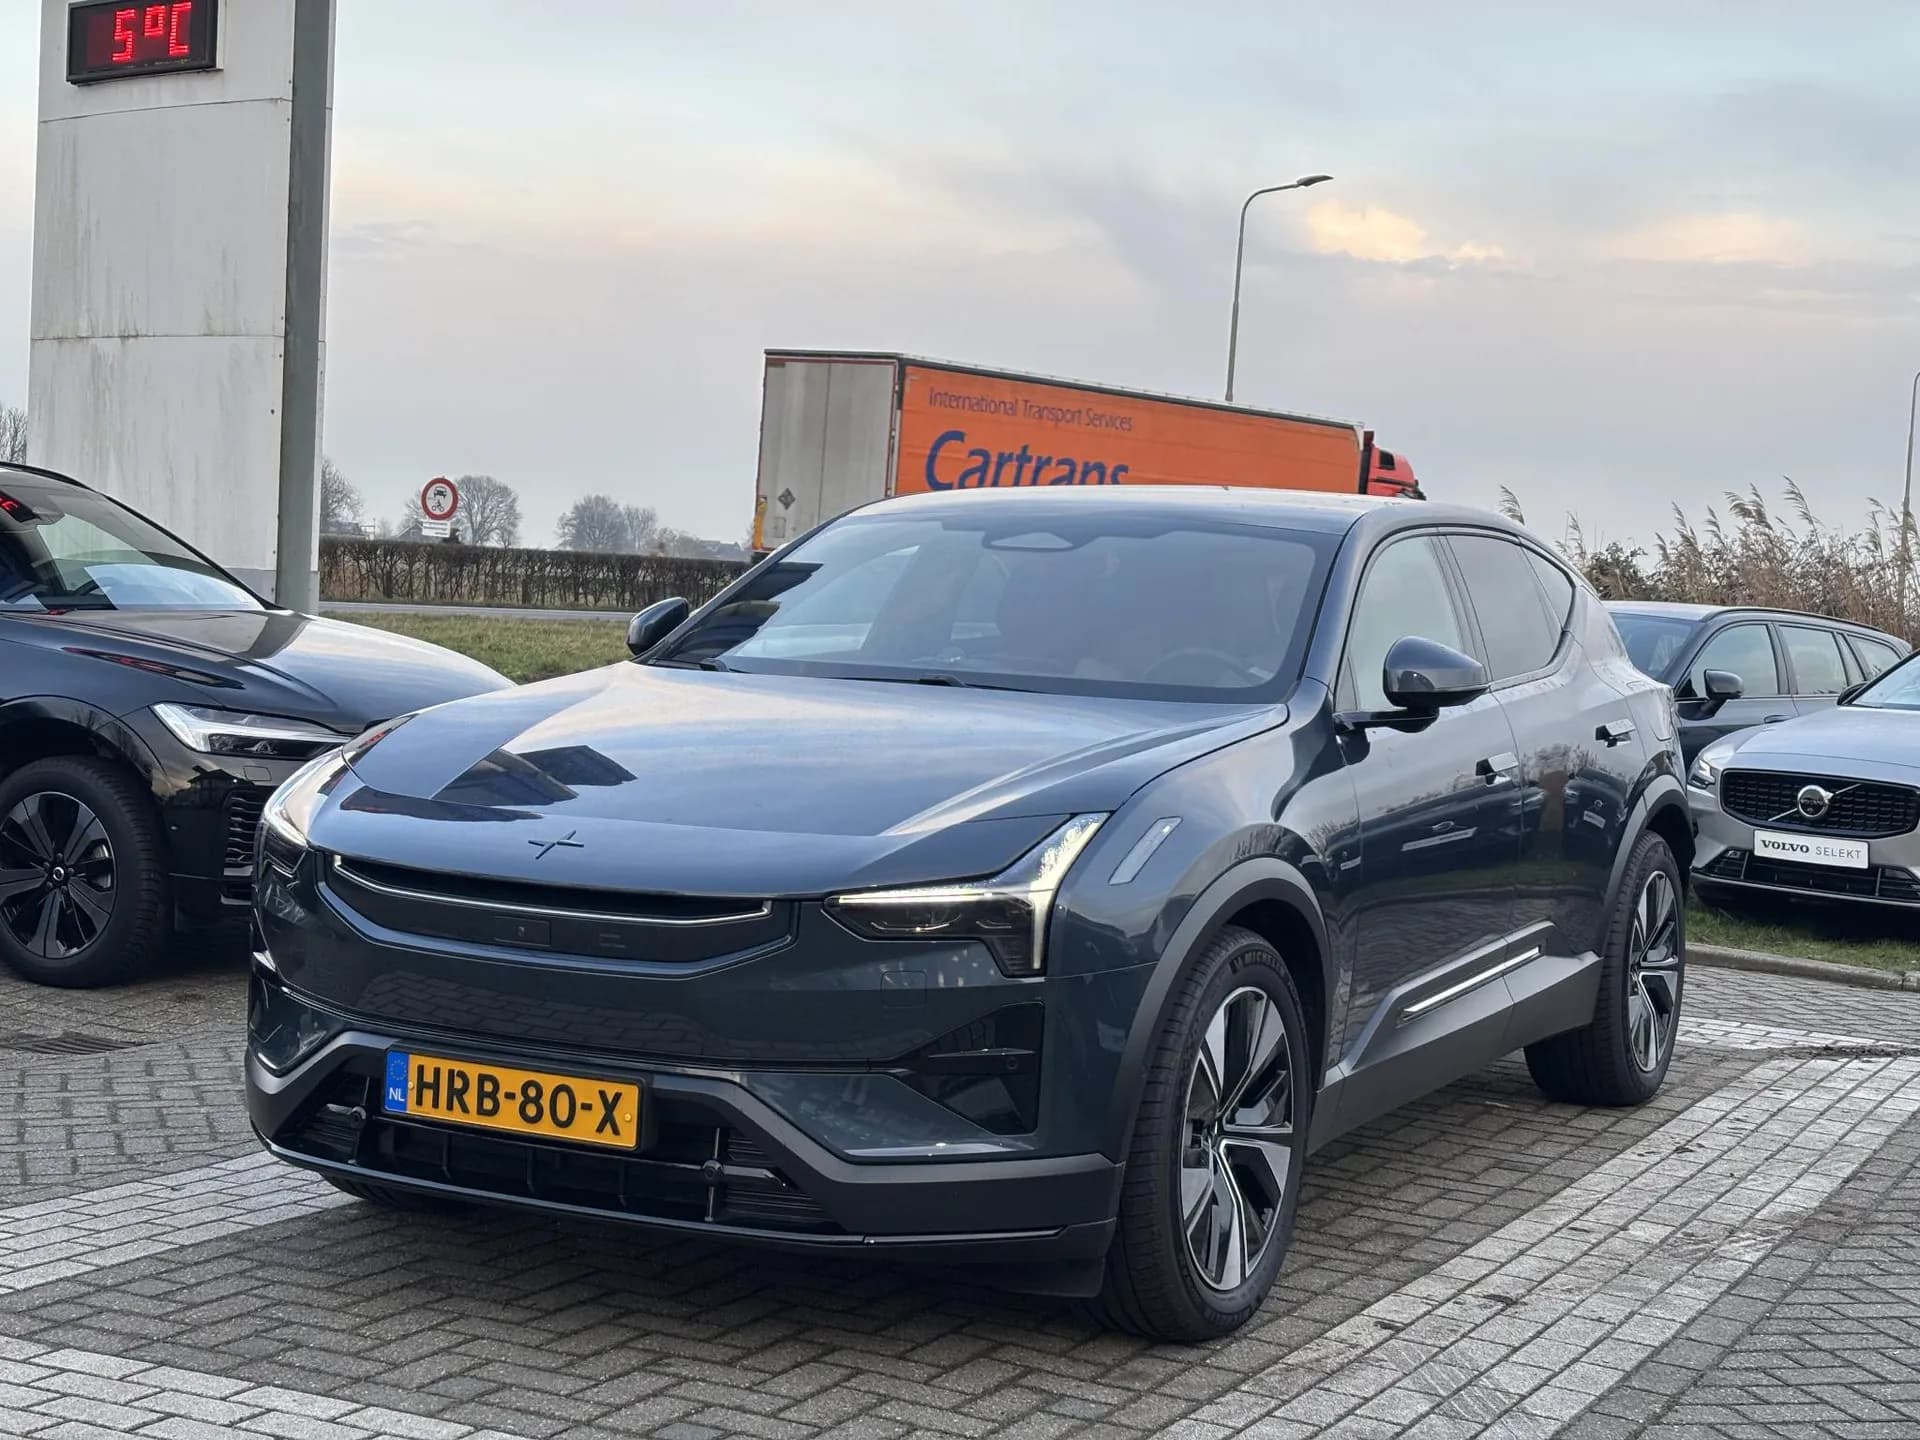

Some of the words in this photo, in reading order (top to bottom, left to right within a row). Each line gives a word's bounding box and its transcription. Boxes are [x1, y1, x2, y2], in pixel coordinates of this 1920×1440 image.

[929, 385, 1017, 416] International
[1023, 399, 1082, 428] Transport
[1086, 407, 1132, 432] Services
[1761, 839, 1810, 854] VOLVO
[1815, 846, 1862, 859] SELEKT
[388, 1086, 405, 1102] NL
[415, 1064, 623, 1136] HRB-80-X
